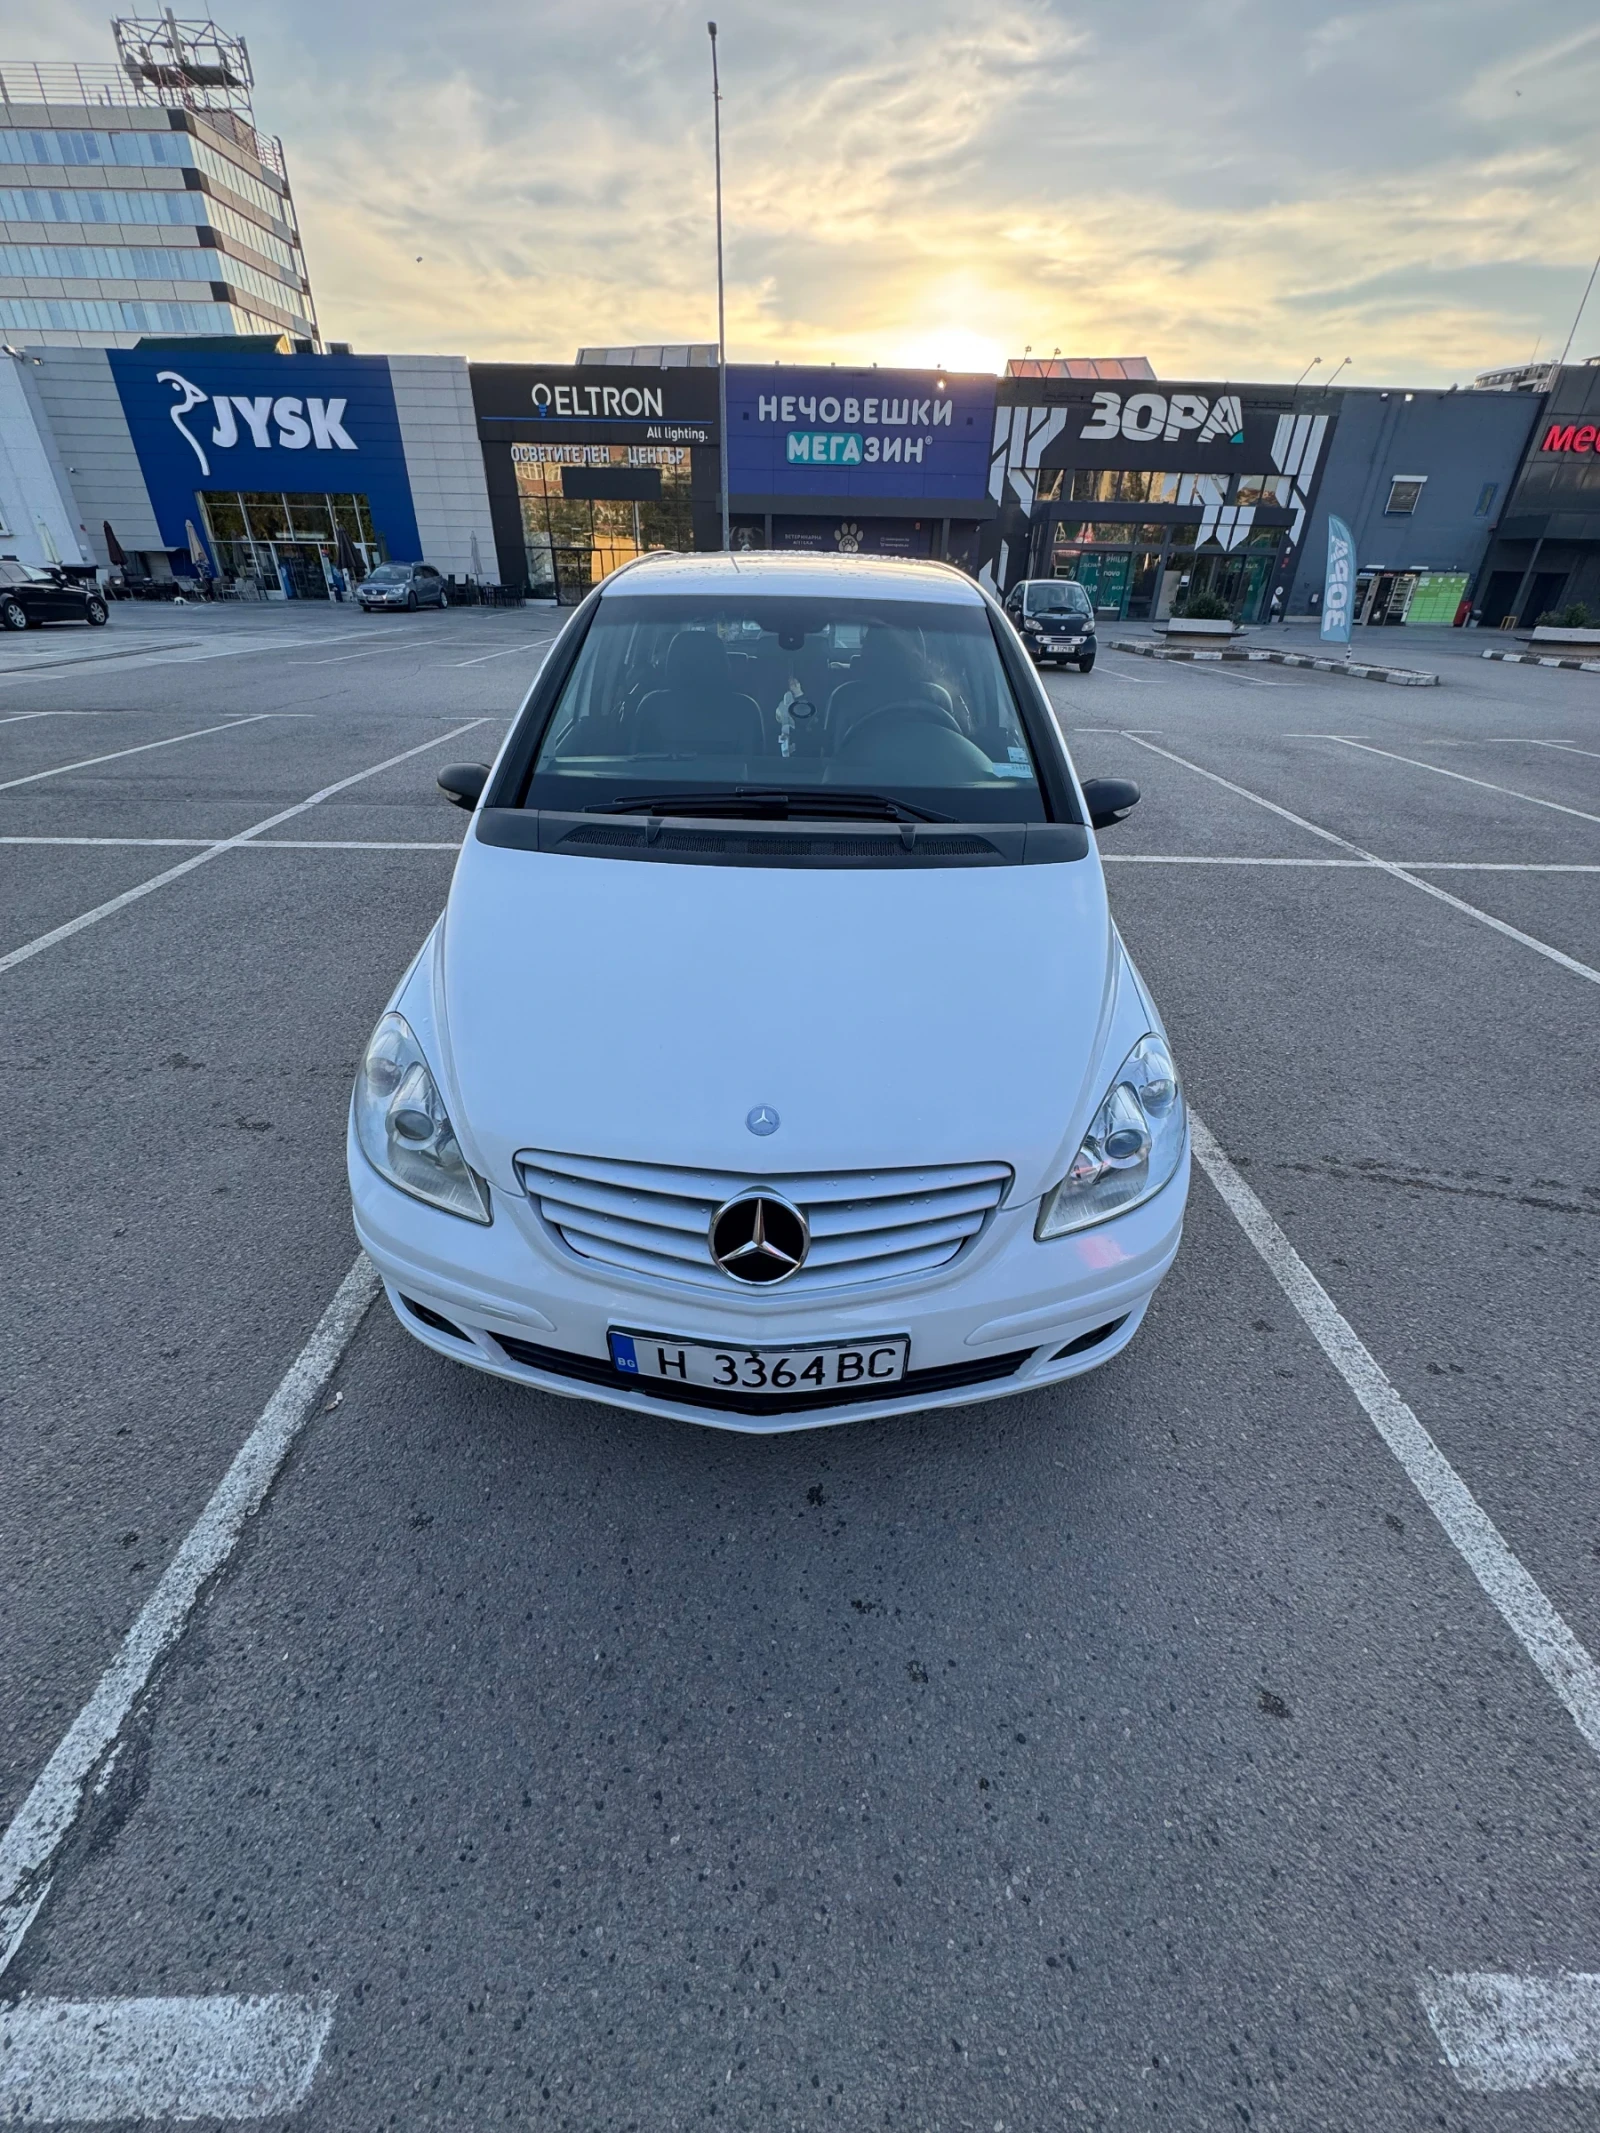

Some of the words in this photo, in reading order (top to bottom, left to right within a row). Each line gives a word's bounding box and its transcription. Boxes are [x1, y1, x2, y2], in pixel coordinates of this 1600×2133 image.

[555, 386, 664, 418] ELTRON
[758, 395, 953, 427] НЕЧОВЕШКИ
[1079, 392, 1244, 443] ЗОРА
[212, 396, 358, 450] JYSK
[646, 426, 663, 440] All
[664, 427, 709, 442] lighting.
[511, 446, 610, 464] ОСВЕТИТЕЛЕН
[628, 447, 684, 465] ЦЕНТЪР
[1323, 535, 1349, 632] ЗОРА
[617, 1357, 636, 1368] BG
[657, 1347, 688, 1379] H
